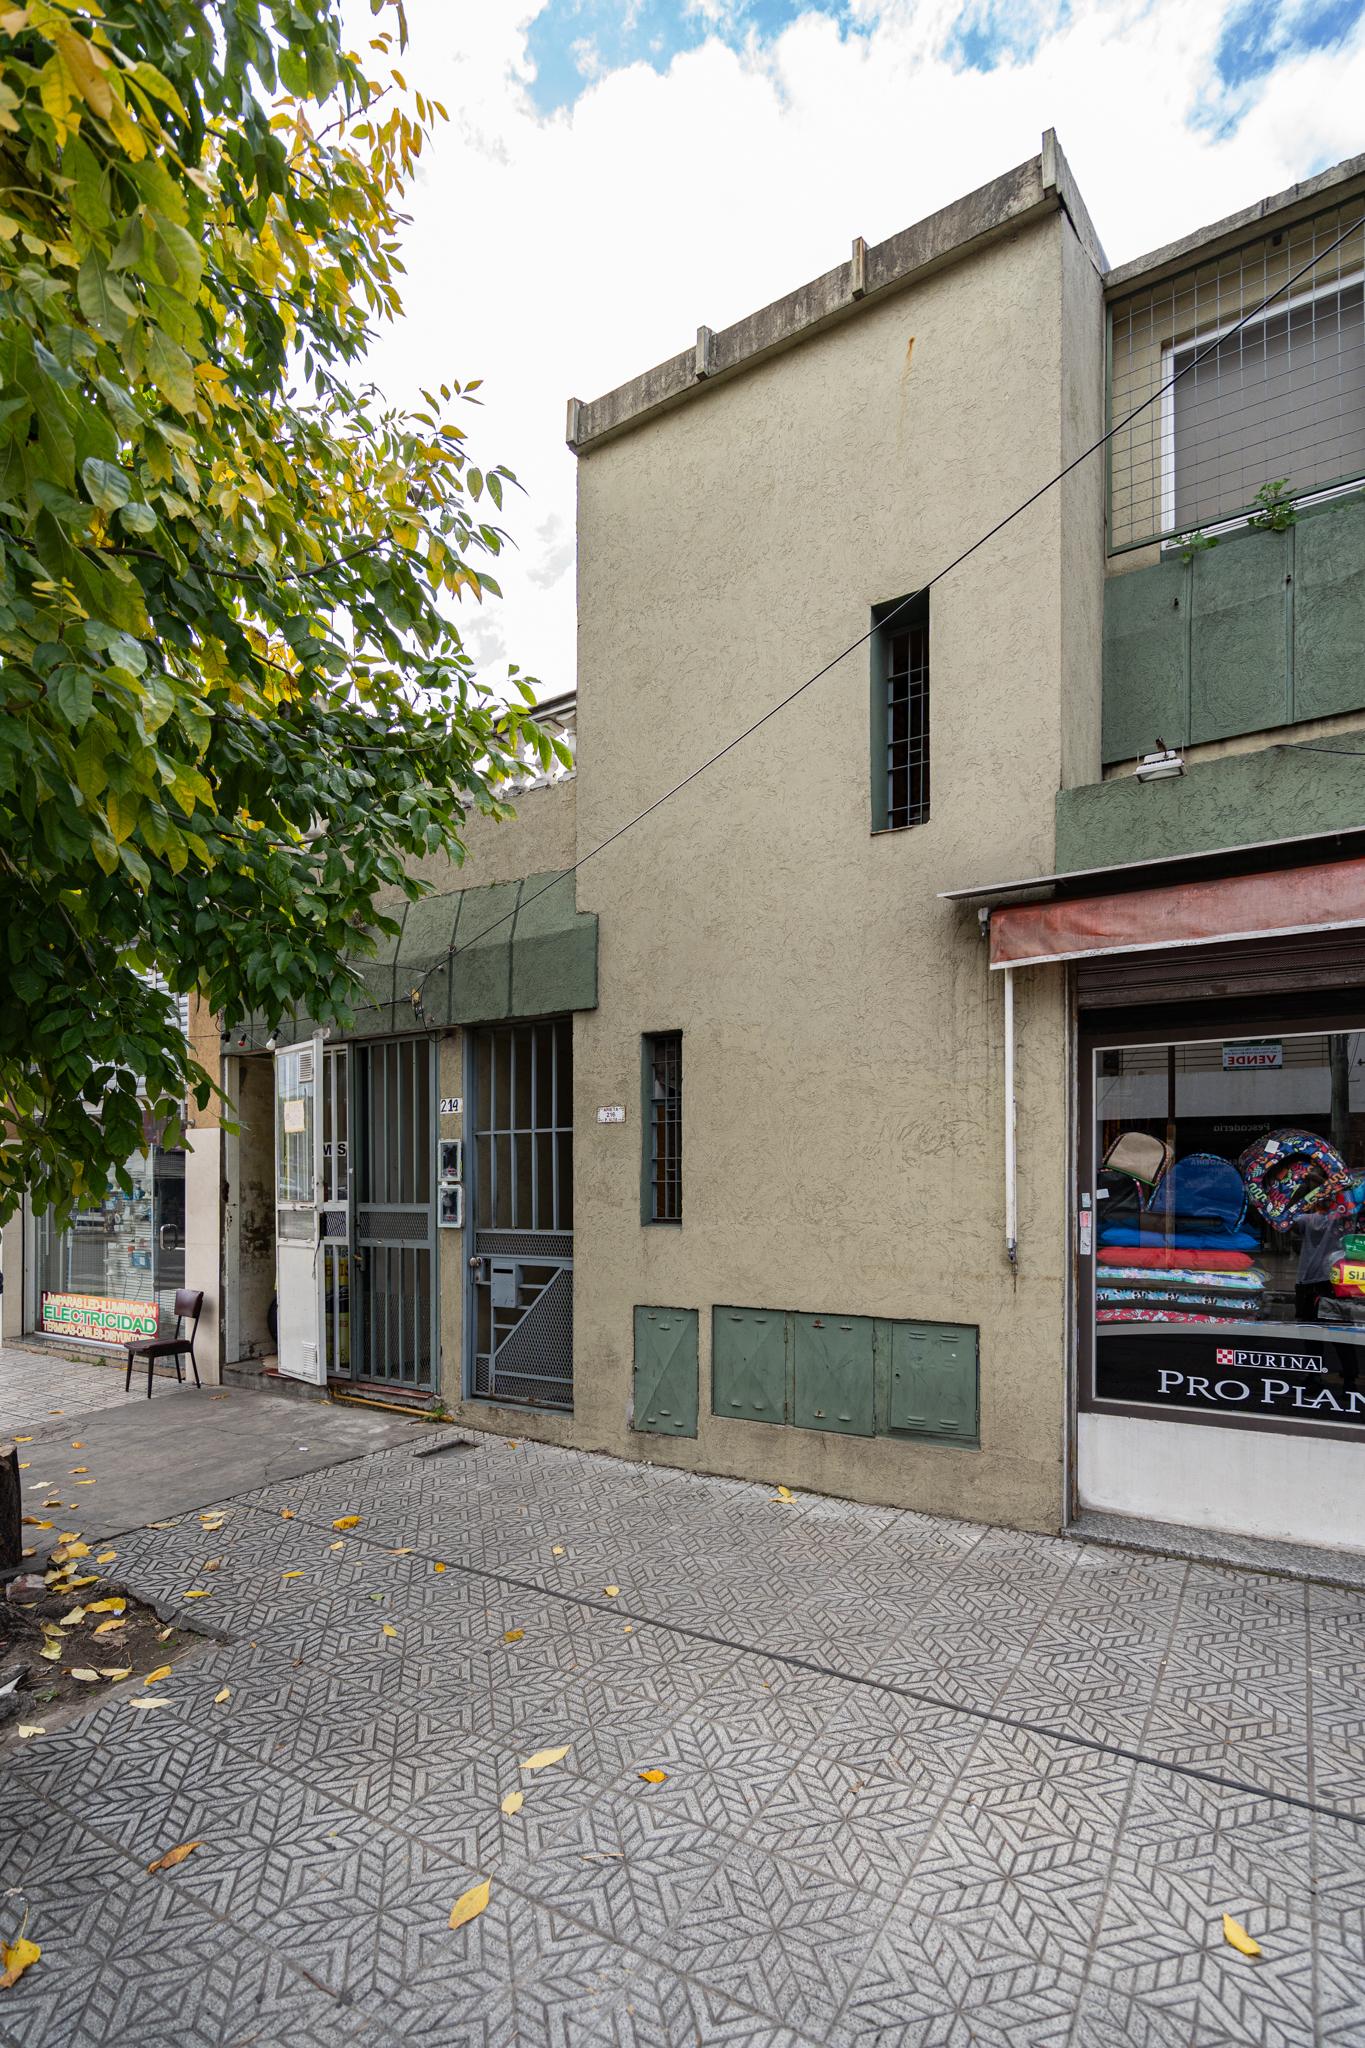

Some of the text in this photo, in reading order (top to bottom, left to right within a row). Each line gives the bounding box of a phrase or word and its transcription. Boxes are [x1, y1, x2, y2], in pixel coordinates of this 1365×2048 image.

[43, 1304, 158, 1335] ELECTRICIDAD
[1237, 1352, 1319, 1371] PURINA
[1157, 1369, 1250, 1401] PRO
